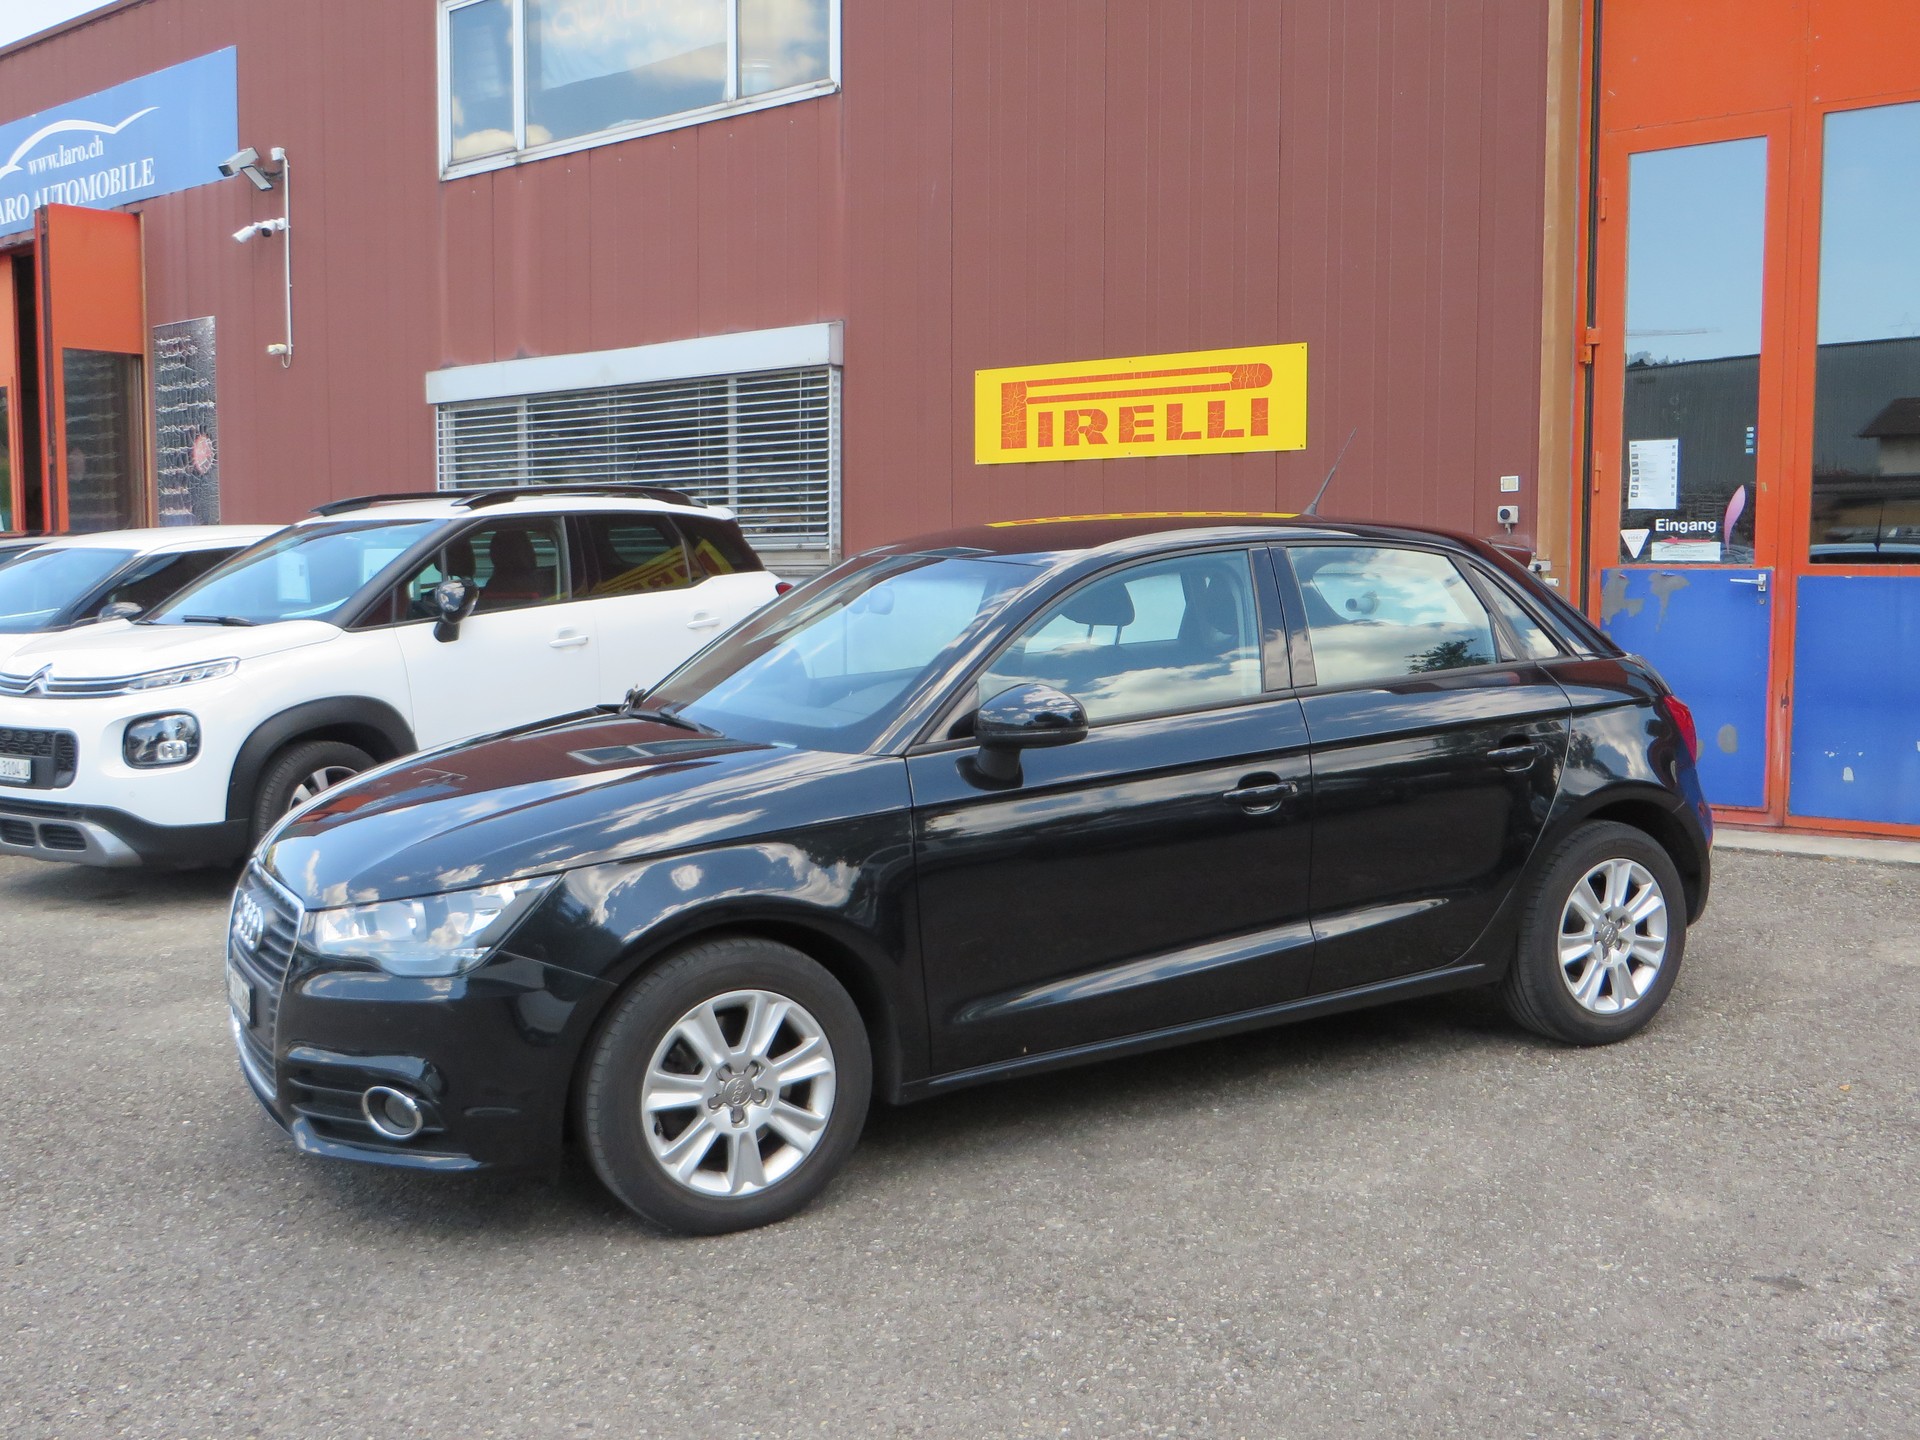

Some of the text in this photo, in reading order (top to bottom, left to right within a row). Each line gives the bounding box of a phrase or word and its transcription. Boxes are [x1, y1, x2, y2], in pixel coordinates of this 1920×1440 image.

[27, 134, 105, 176] www.laro.ch
[33, 157, 156, 209] AUTOMOBILE
[1000, 362, 1273, 450] PIRELLI
[1655, 518, 1717, 534] Eingang
